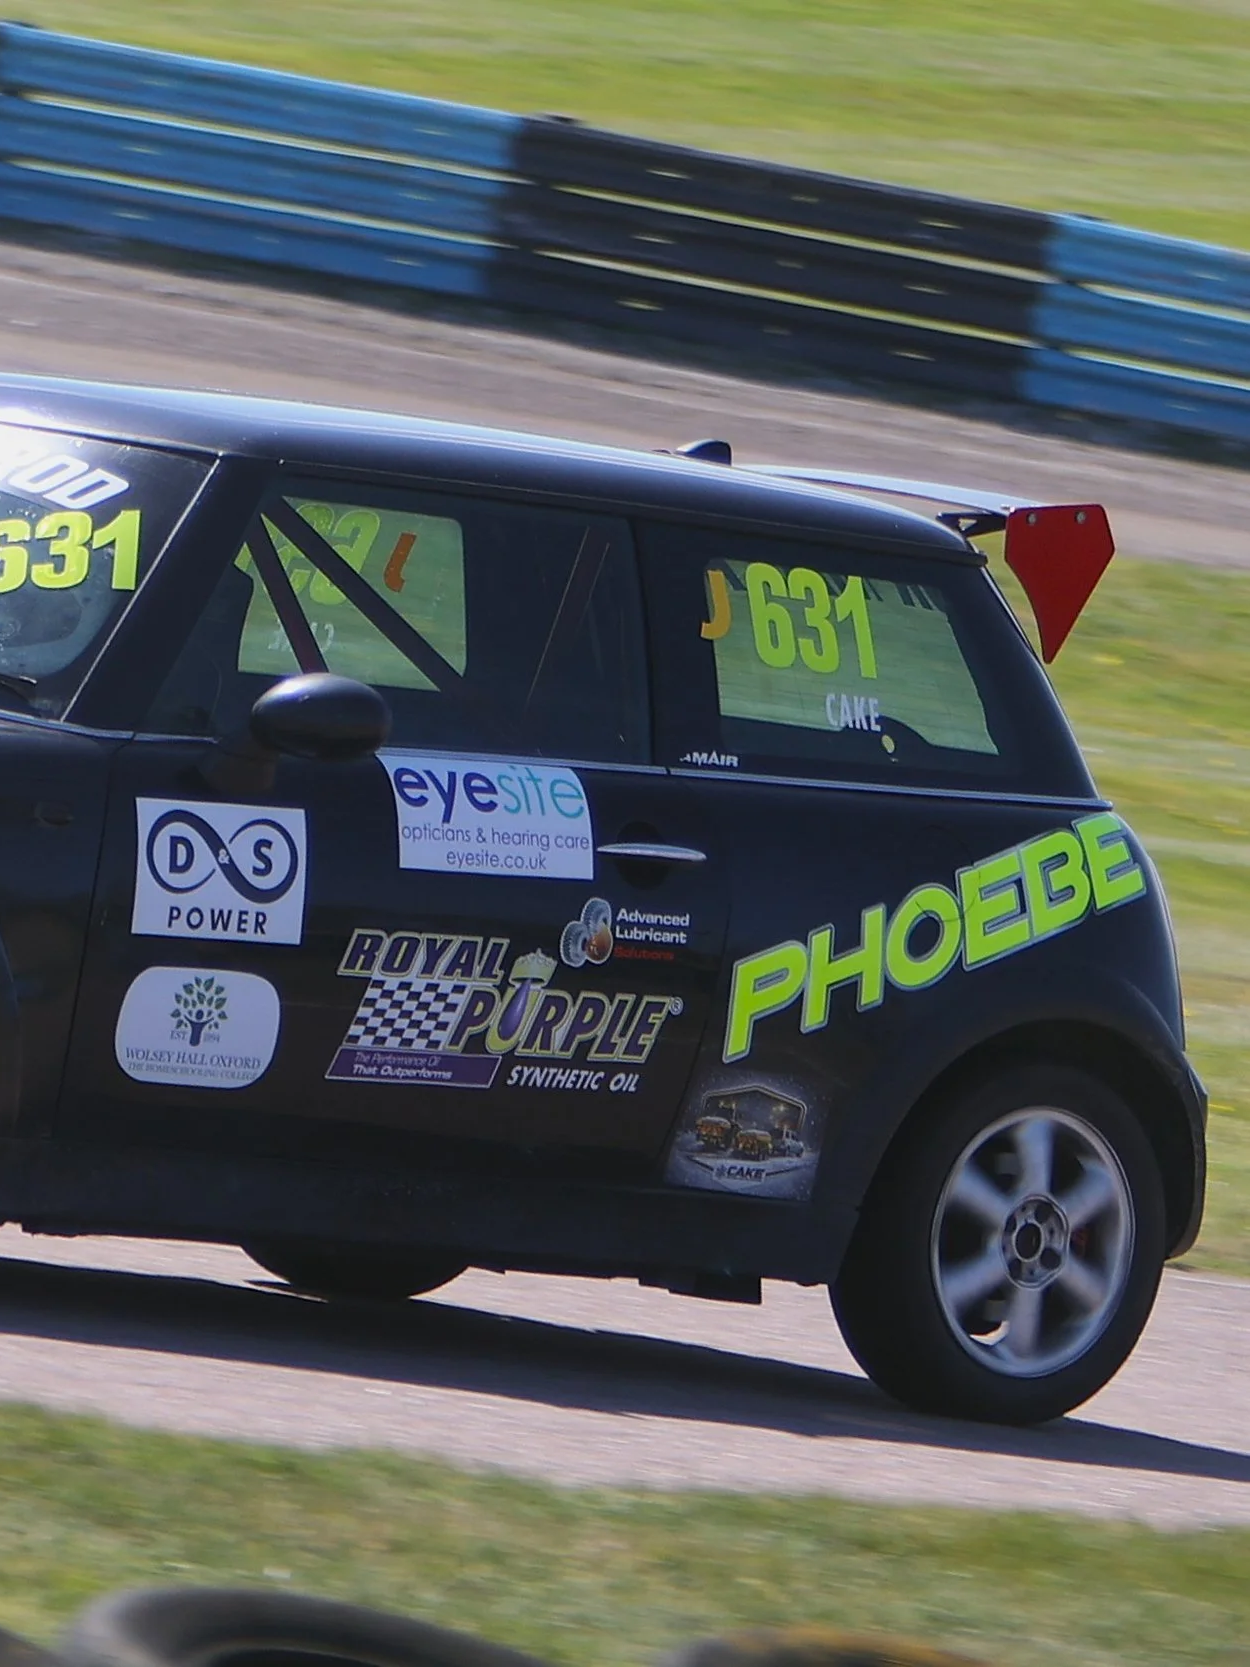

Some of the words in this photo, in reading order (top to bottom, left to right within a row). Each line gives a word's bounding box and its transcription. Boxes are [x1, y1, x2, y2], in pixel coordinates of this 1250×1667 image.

[700, 569, 732, 640] J
[745, 562, 877, 679] 631
[825, 693, 882, 732] CAKE
[393, 765, 585, 824] eyesite
[401, 823, 471, 843] opticians
[476, 828, 487, 844] &
[491, 827, 550, 851] hearing
[554, 833, 590, 850] care
[168, 835, 195, 874] D
[251, 838, 274, 877] S
[447, 849, 547, 870] eyesite.co.uk
[167, 906, 268, 935] POWER
[616, 907, 690, 927] Advanced
[615, 925, 687, 943] Lubricant
[722, 812, 1147, 1063] PHOEBE
[336, 928, 510, 984] ROYAL
[126, 1047, 174, 1063] WOLSEY
[176, 1051, 207, 1066] HALL
[209, 1055, 261, 1070] OXFORD
[352, 1064, 376, 1076] That
[380, 1065, 453, 1079] Outperforms
[507, 1065, 605, 1091] SYNTHETIC
[609, 1072, 642, 1093] OIL
[726, 1165, 766, 1180] CAKE
